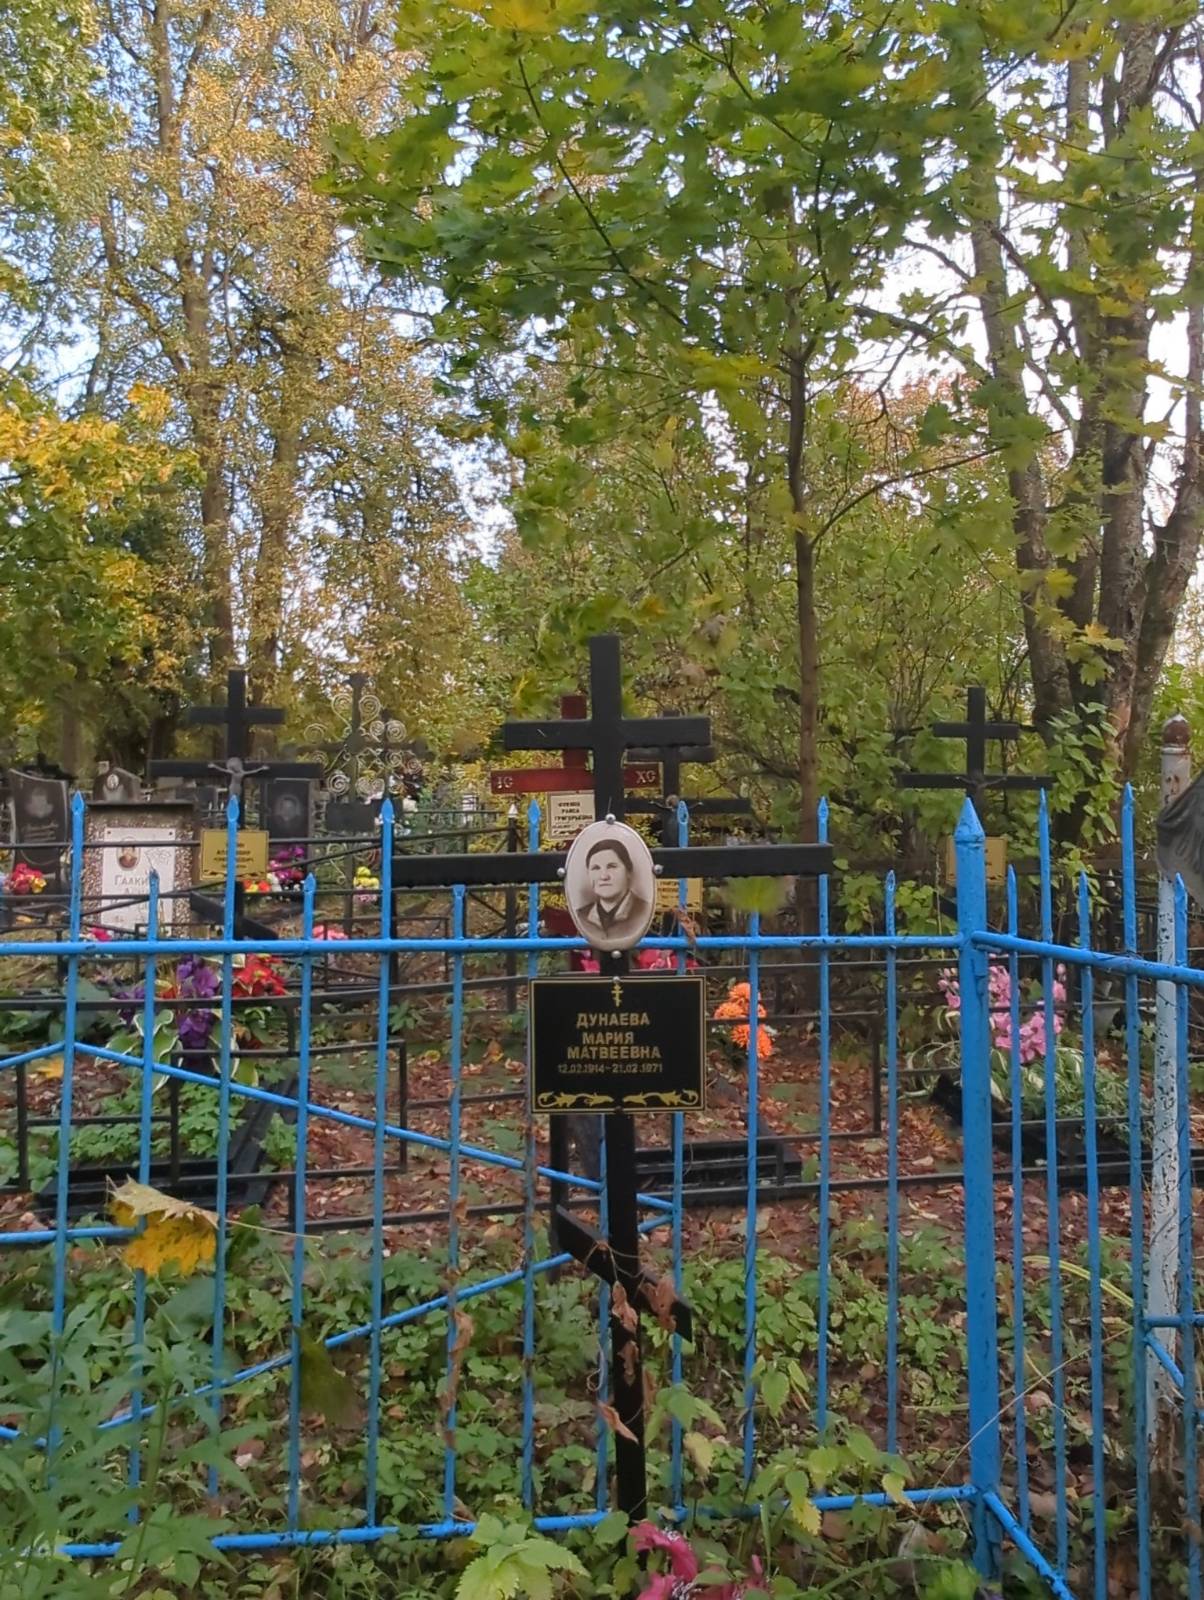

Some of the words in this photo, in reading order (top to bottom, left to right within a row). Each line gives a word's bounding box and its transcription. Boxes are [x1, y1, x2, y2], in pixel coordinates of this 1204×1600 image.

[576, 1012, 650, 1029] ДУНАЕВА
[582, 1031, 635, 1045] МАРИЯ
[567, 1045, 661, 1060] МАТВЕЕВНА
